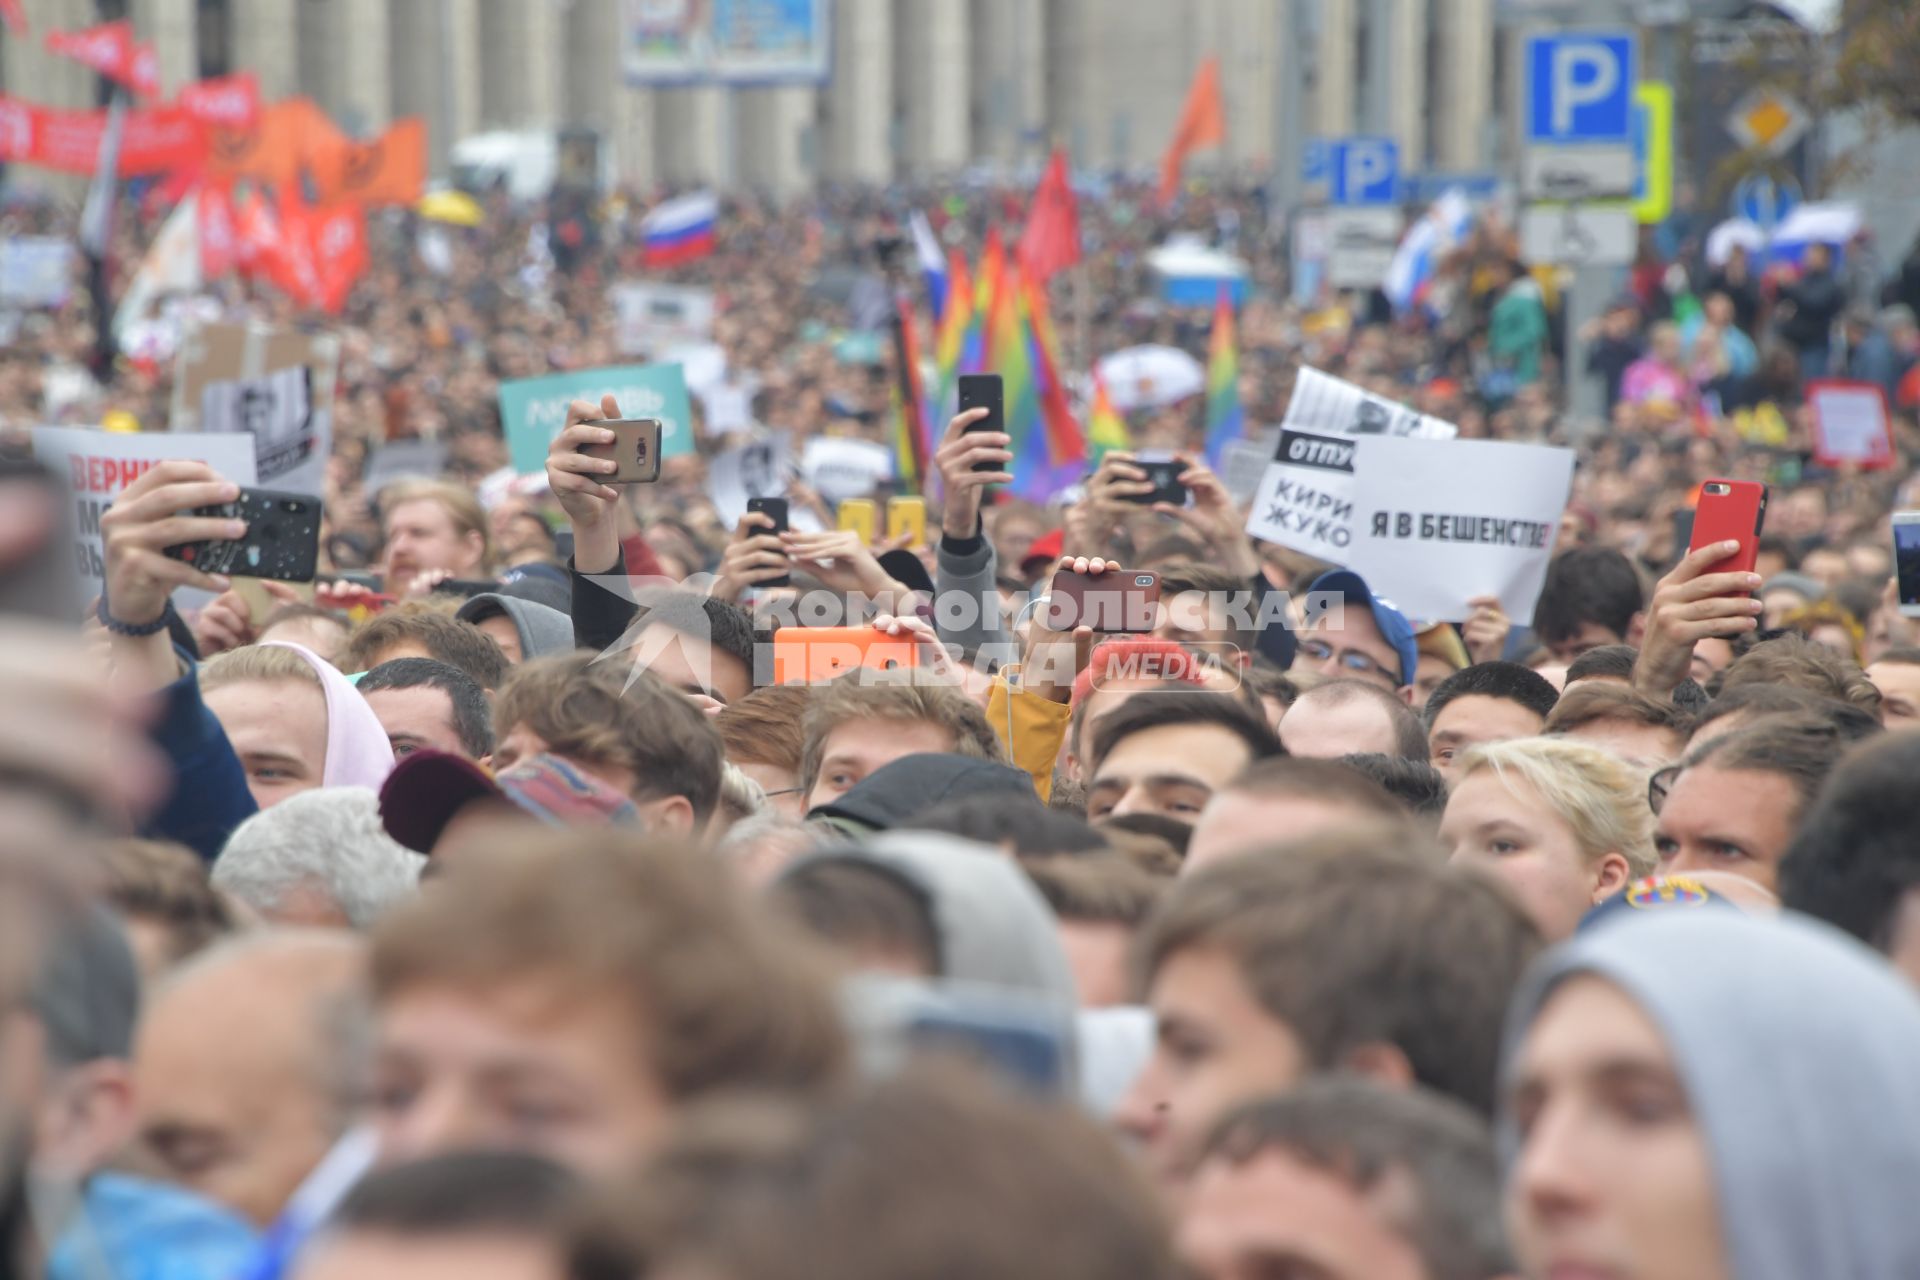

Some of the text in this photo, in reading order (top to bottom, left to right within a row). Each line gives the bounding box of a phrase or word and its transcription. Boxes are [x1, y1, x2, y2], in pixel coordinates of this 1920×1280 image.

[1553, 41, 1620, 134] P
[1346, 142, 1389, 202] P
[1288, 437, 1354, 465] ОТПУ
[69, 454, 208, 492] ВЕРН
[77, 500, 112, 535] М
[1275, 478, 1353, 521] КИРИ
[1264, 504, 1352, 548] ЖУКО
[1370, 511, 1389, 538] Я
[1395, 512, 1413, 539] В
